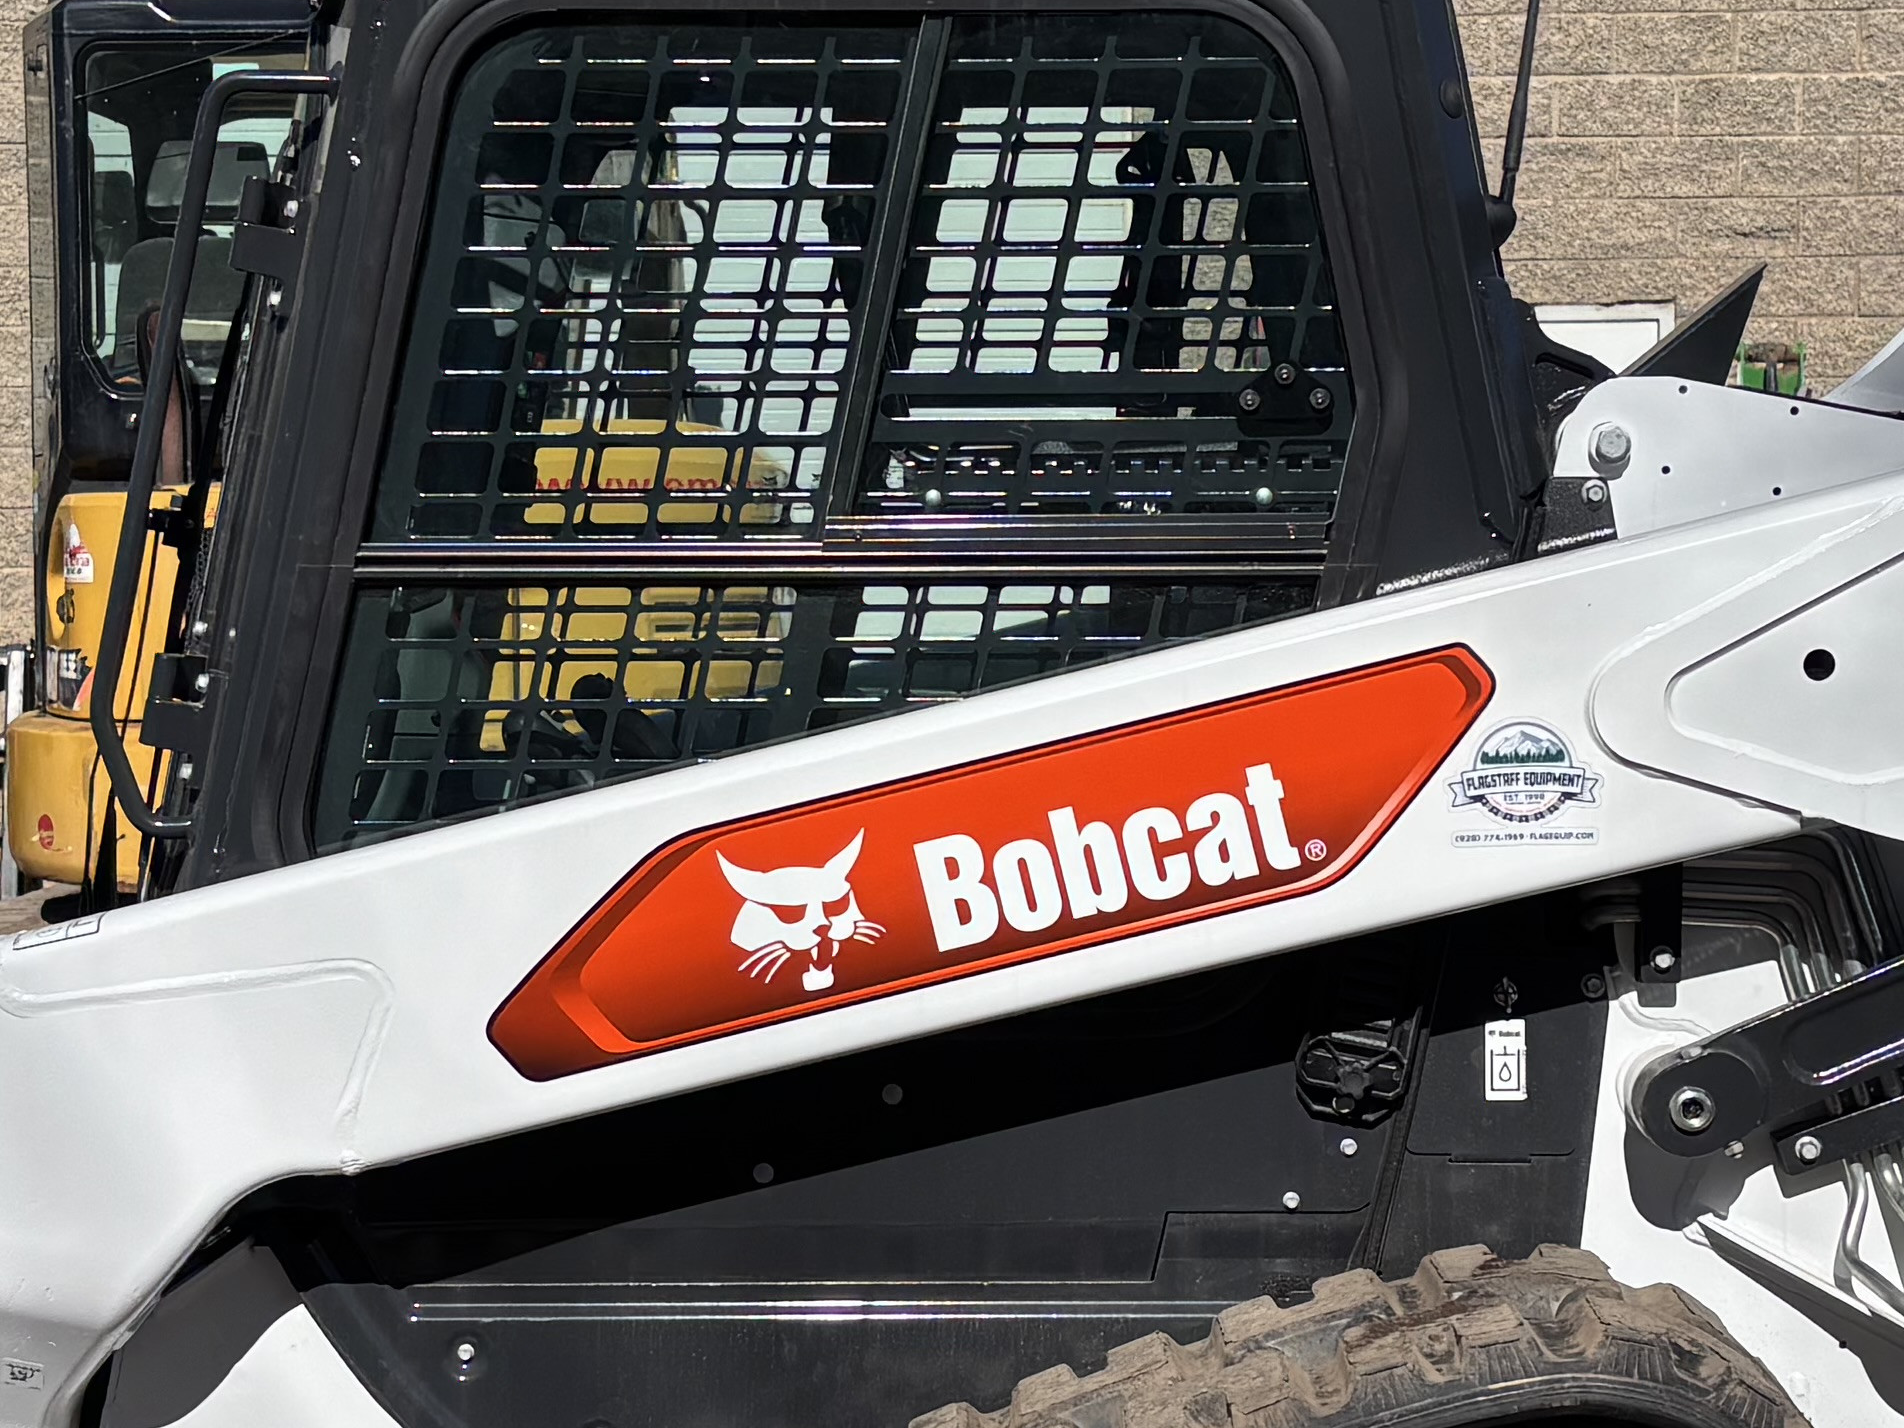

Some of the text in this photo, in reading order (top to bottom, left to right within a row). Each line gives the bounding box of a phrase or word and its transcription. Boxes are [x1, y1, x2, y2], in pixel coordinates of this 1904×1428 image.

[1465, 771, 1582, 791] FLAGSTAFF EQUIPMENT
[911, 762, 1302, 954] Bobcat
